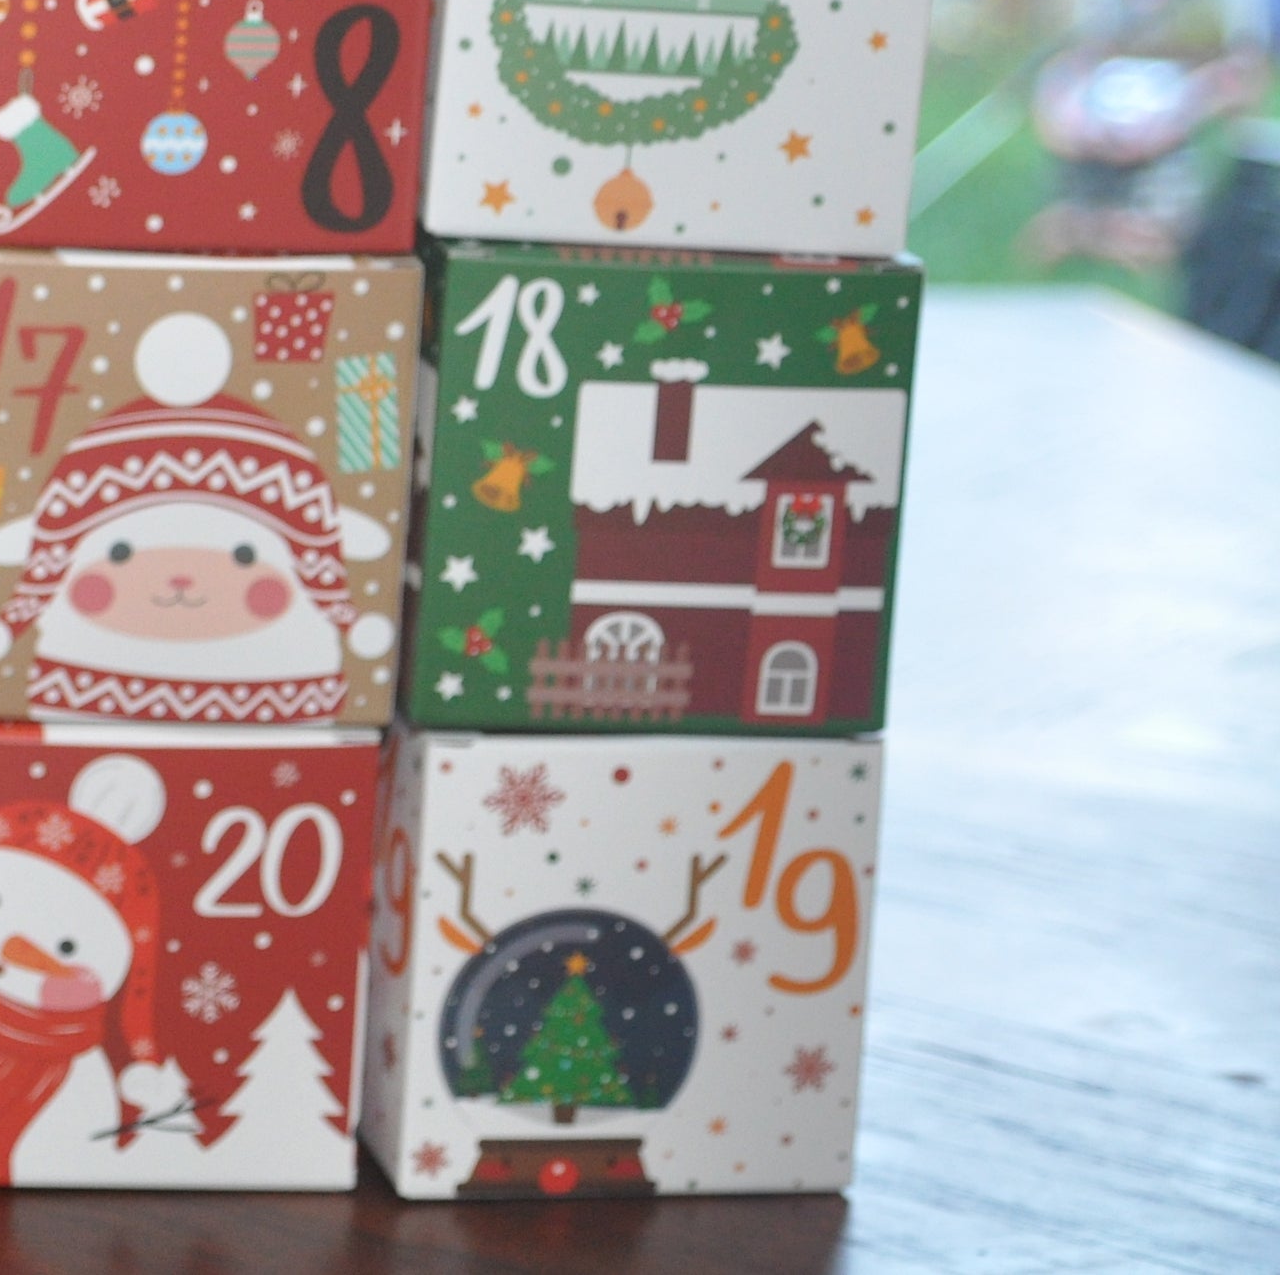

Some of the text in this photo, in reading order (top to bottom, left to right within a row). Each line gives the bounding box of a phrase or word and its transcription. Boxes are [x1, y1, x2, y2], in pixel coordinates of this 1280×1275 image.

[300, 3, 400, 231] 8
[454, 274, 569, 398] 18
[193, 803, 344, 919] 20
[717, 759, 863, 995] 19
